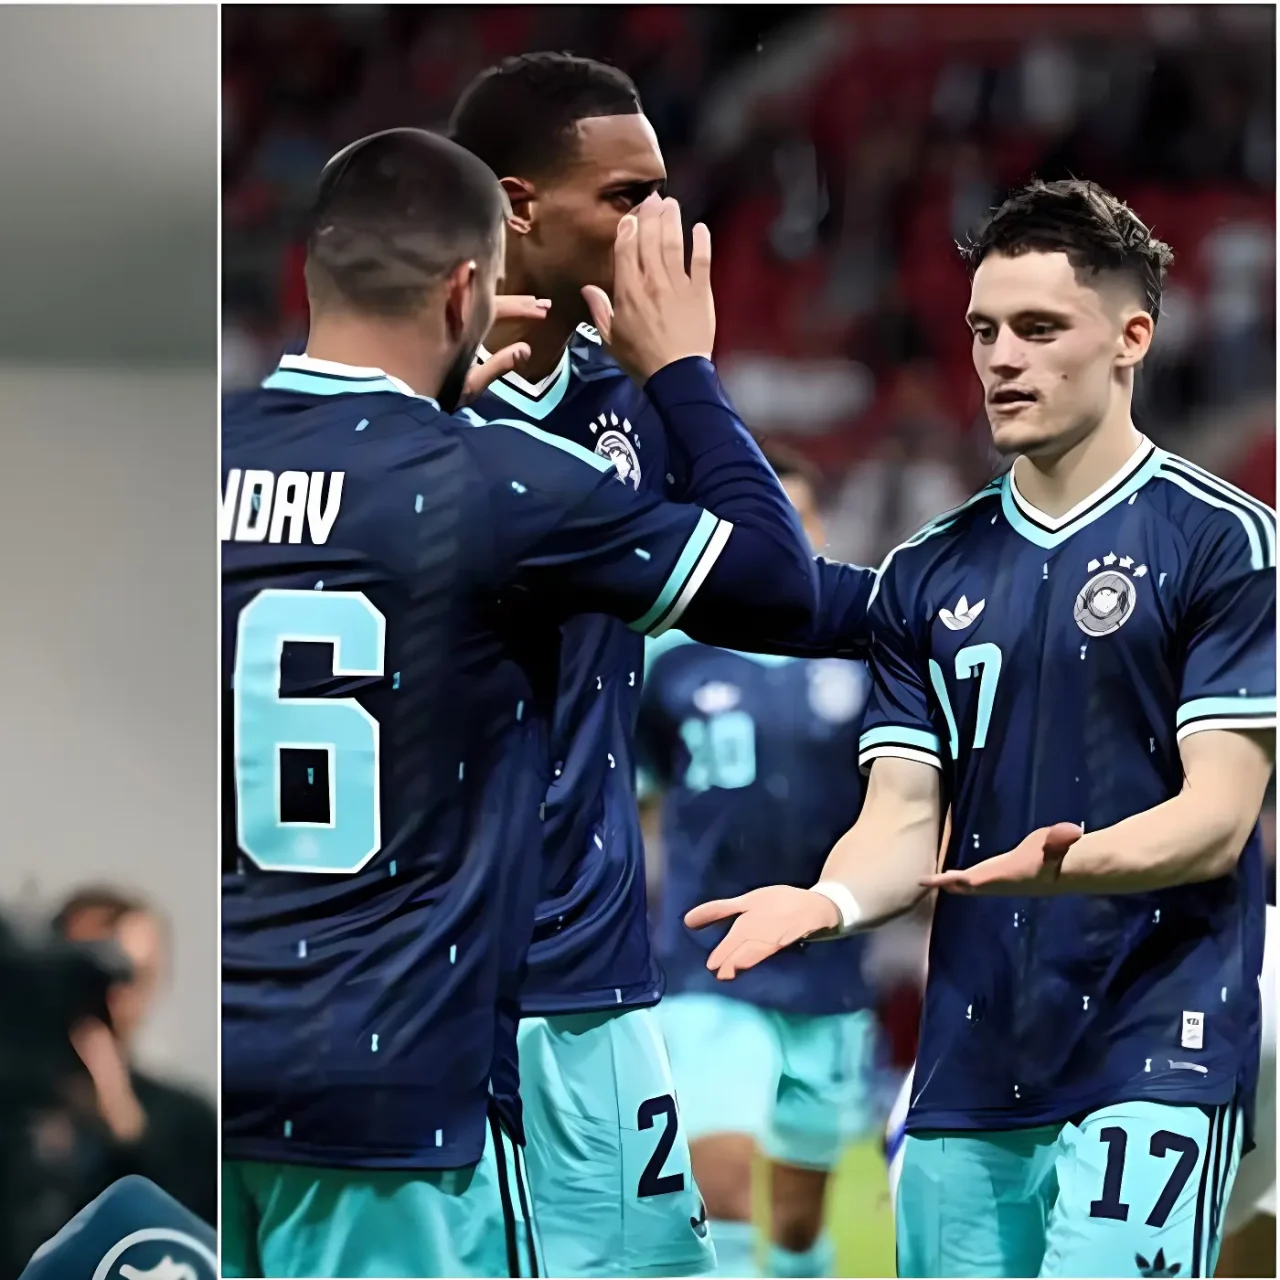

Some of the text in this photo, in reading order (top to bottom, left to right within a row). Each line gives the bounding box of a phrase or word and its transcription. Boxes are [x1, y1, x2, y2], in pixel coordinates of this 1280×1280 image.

[233, 588, 386, 874] 6
[636, 1094, 685, 1198] 2
[1089, 1125, 1200, 1228] 17
